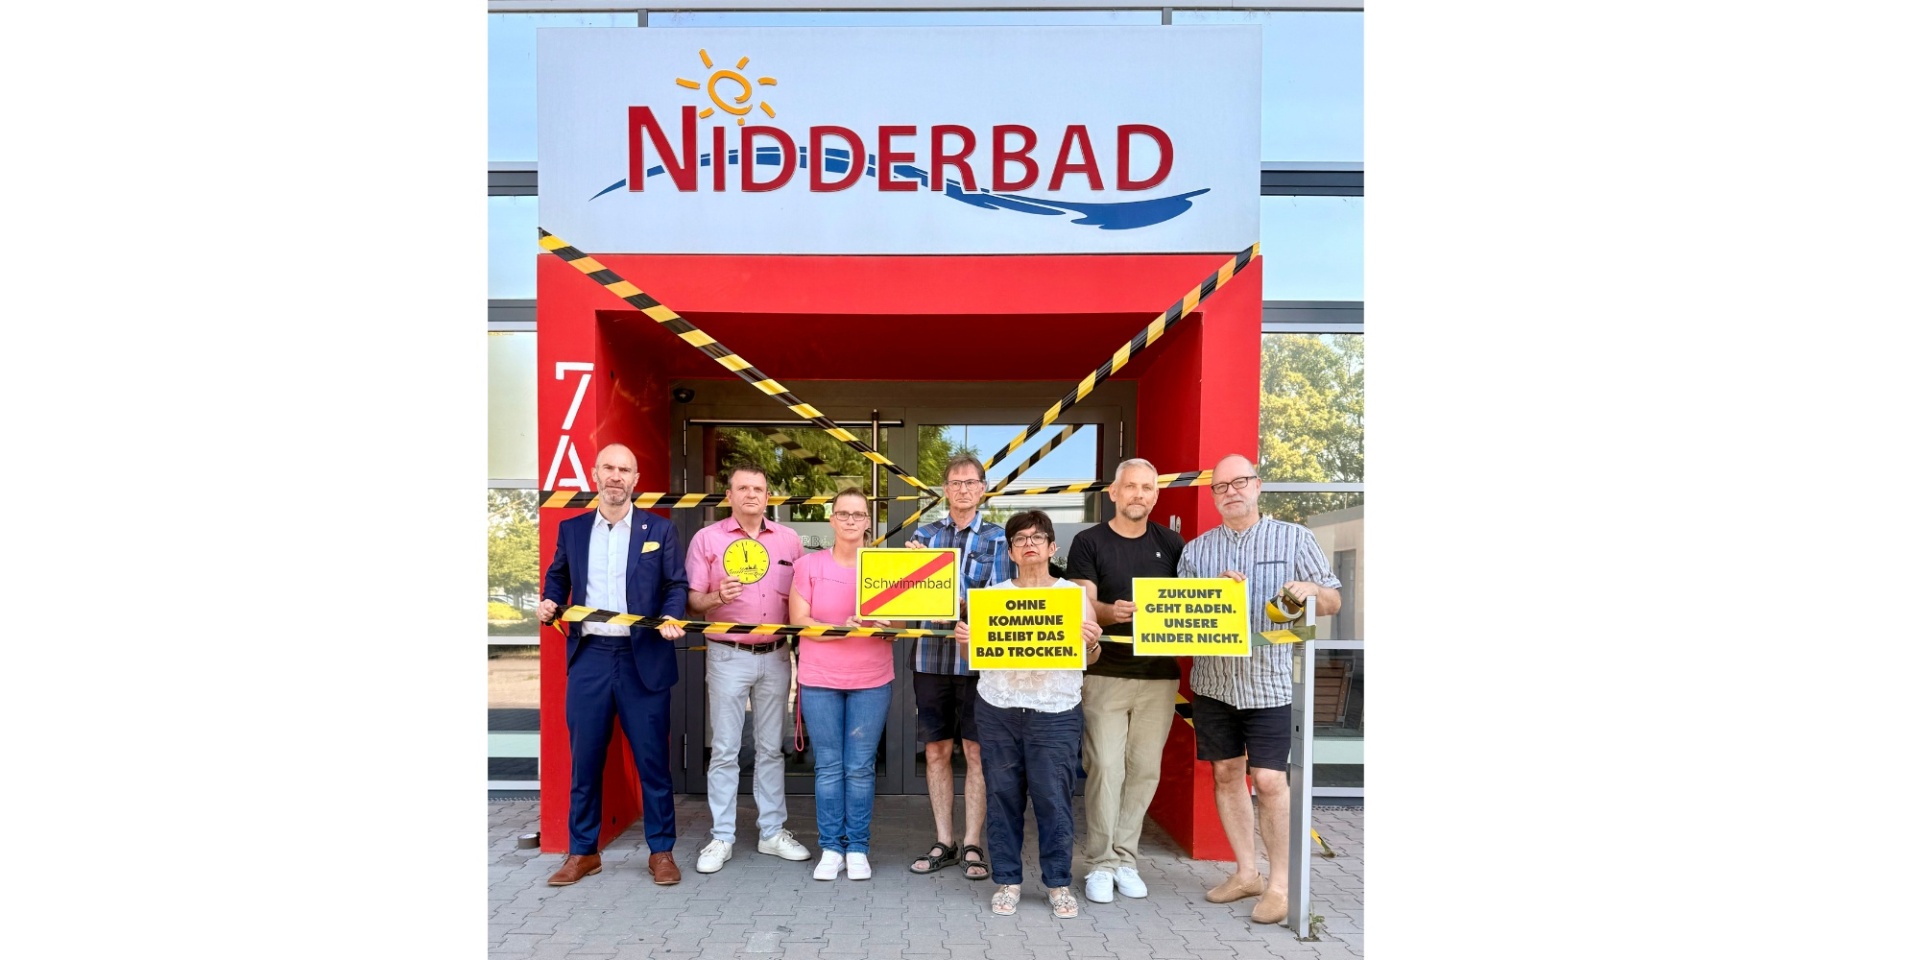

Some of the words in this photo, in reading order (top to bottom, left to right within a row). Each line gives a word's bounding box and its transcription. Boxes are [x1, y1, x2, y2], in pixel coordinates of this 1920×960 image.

[628, 105, 1174, 192] NIDDERBAD
[864, 577, 952, 589] Schwimmbad
[1158, 589, 1222, 599] ZUKUNFT
[1005, 600, 1046, 610] OHNE
[1145, 603, 1181, 613] GEHT
[1185, 603, 1236, 614] BADEN.
[989, 615, 1063, 626] KOMMUNE
[1164, 618, 1218, 628] UNSERE
[988, 631, 1033, 641] BLEIBT
[1037, 631, 1065, 641] DAS
[1141, 633, 1194, 643] KINDER
[1197, 633, 1243, 643] NICHT.
[976, 647, 1004, 657] BAD
[1008, 646, 1078, 657] TROCKEN.
